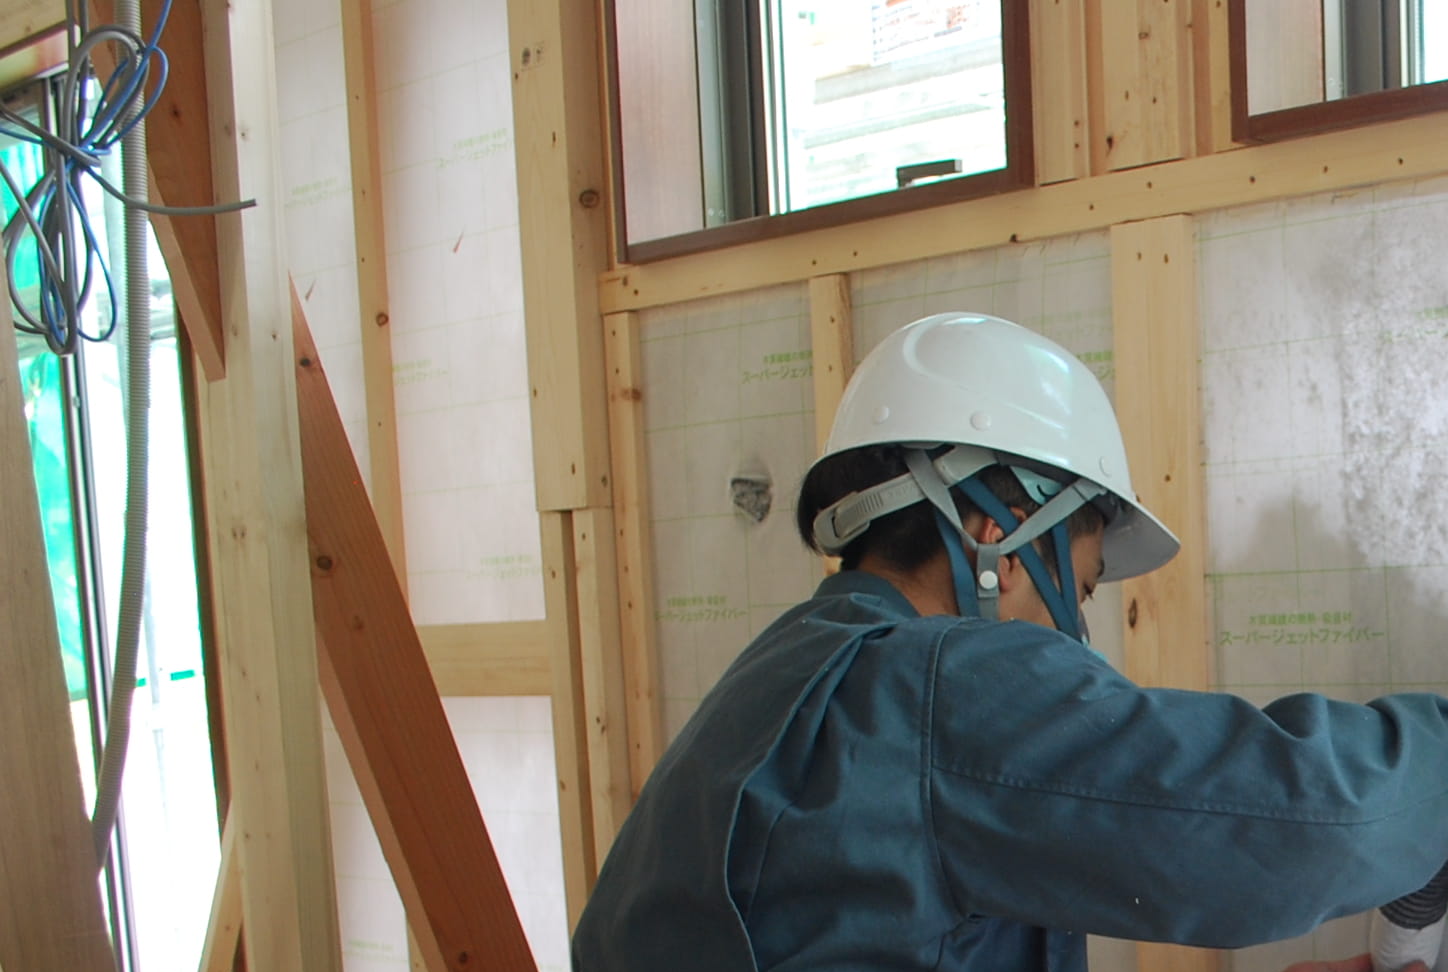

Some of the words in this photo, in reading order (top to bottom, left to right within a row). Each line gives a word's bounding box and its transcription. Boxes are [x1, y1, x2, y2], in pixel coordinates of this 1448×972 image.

[1218, 625, 1385, 647] スーパージェットファイバー
